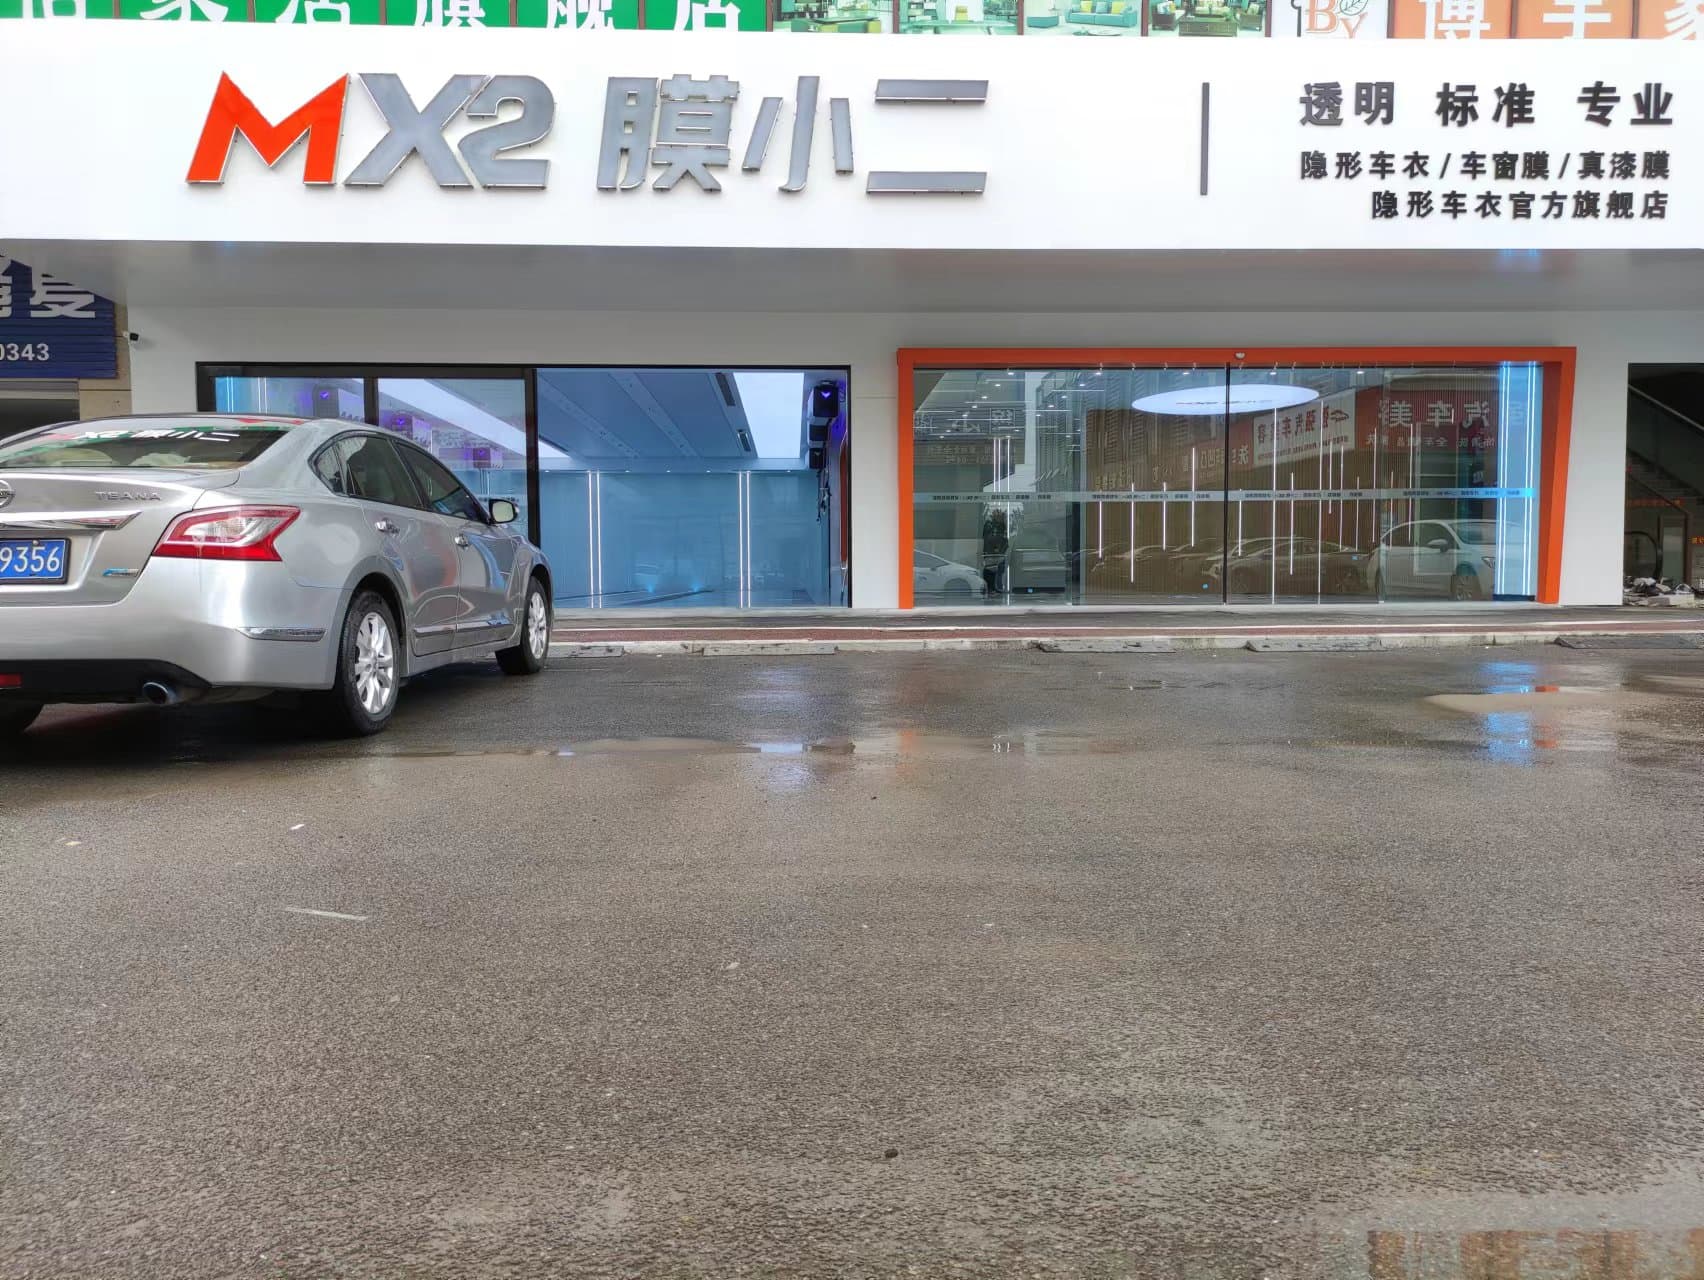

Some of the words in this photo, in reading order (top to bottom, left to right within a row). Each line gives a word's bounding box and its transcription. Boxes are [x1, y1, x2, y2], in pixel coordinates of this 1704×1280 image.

[1299, 81, 1395, 127] 透明
[1436, 81, 1536, 127] 标准
[1577, 81, 1674, 127] 专业
[186, 71, 556, 190] MX2
[597, 74, 989, 196] 膜小二
[1300, 150, 1671, 180] 隐形车衣/车窗膜/真漆膜
[1371, 191, 1669, 219] 隐形车衣官方旗舰店
[95, 490, 161, 501] TEANA
